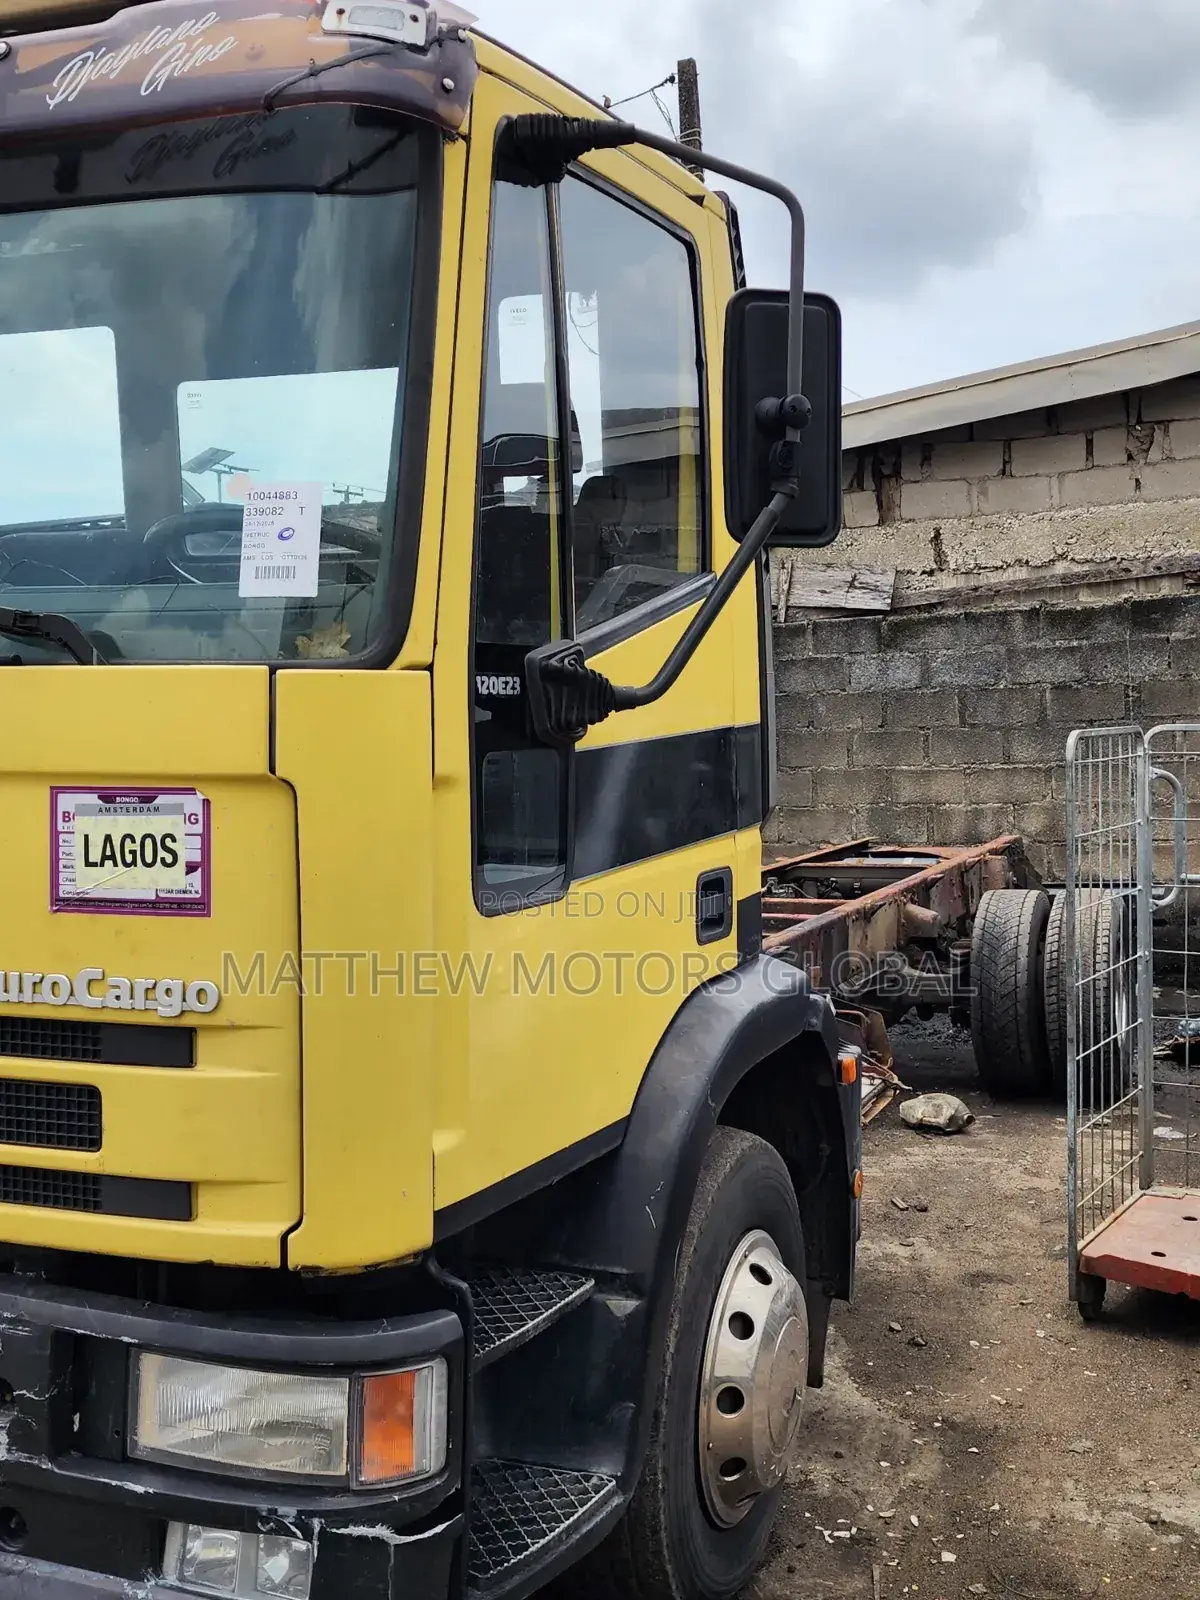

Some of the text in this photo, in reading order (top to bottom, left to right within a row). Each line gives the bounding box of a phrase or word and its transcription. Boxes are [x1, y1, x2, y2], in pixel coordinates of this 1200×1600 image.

[140, 36, 238, 96] Gino
[247, 491, 298, 500] 10044883
[245, 506, 306, 517] 339082 T
[83, 833, 179, 868] LAGOS
